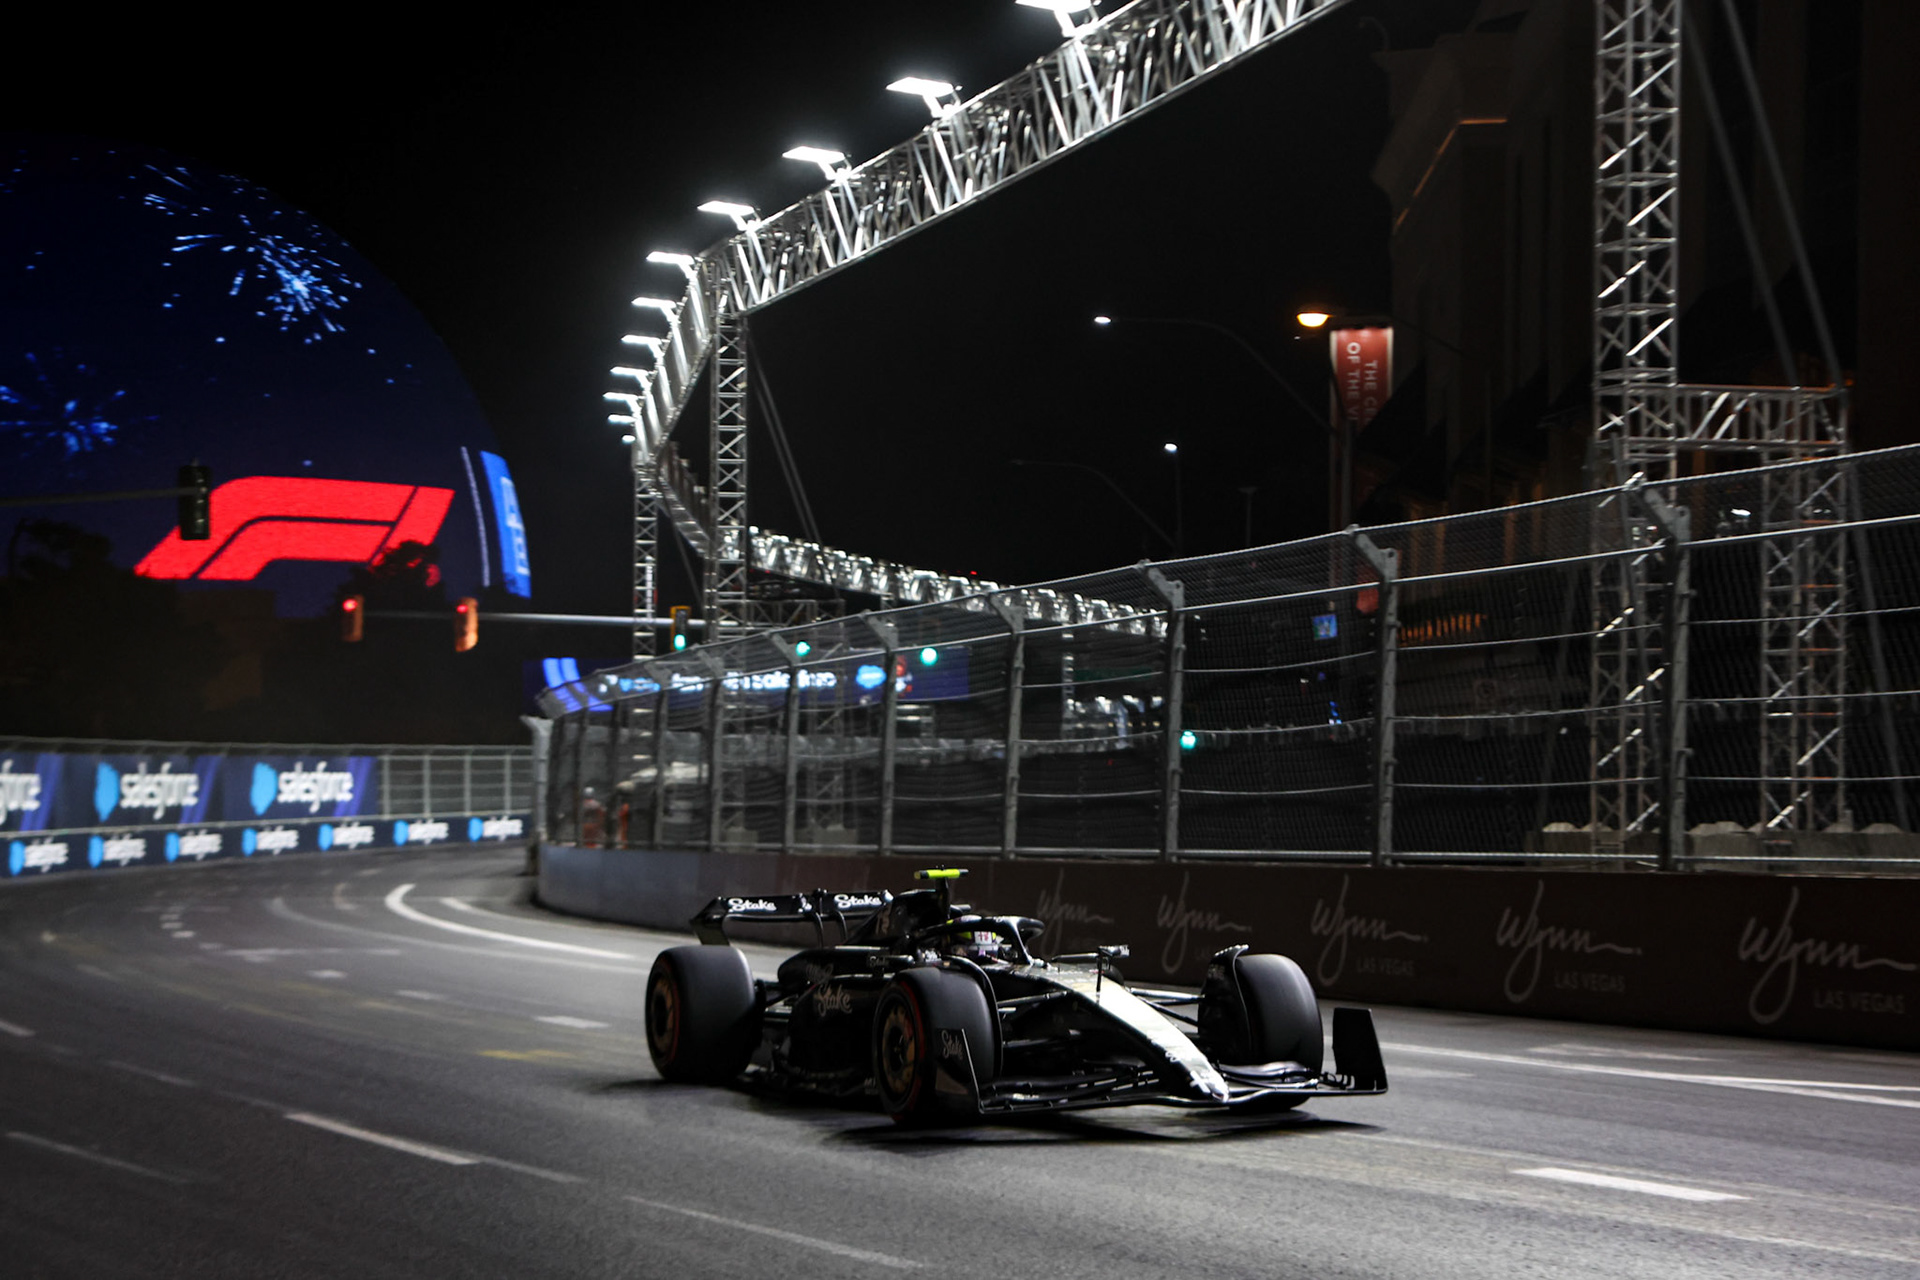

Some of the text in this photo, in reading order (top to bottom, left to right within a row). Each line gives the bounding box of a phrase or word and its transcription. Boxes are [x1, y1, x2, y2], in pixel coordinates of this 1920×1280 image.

[1346, 341, 1361, 364] OF
[1347, 368, 1360, 399] THE
[1364, 359, 1378, 390] THE
[728, 897, 777, 913] Stake
[834, 894, 882, 908] Stake
[1310, 873, 1429, 986] Wynn
[1496, 879, 1642, 1004] Wynn
[1737, 885, 1920, 1026] Wynn
[1554, 970, 1626, 993] LAS VEGAS
[817, 983, 854, 1017] Stake
[1813, 989, 1844, 1009] LAS
